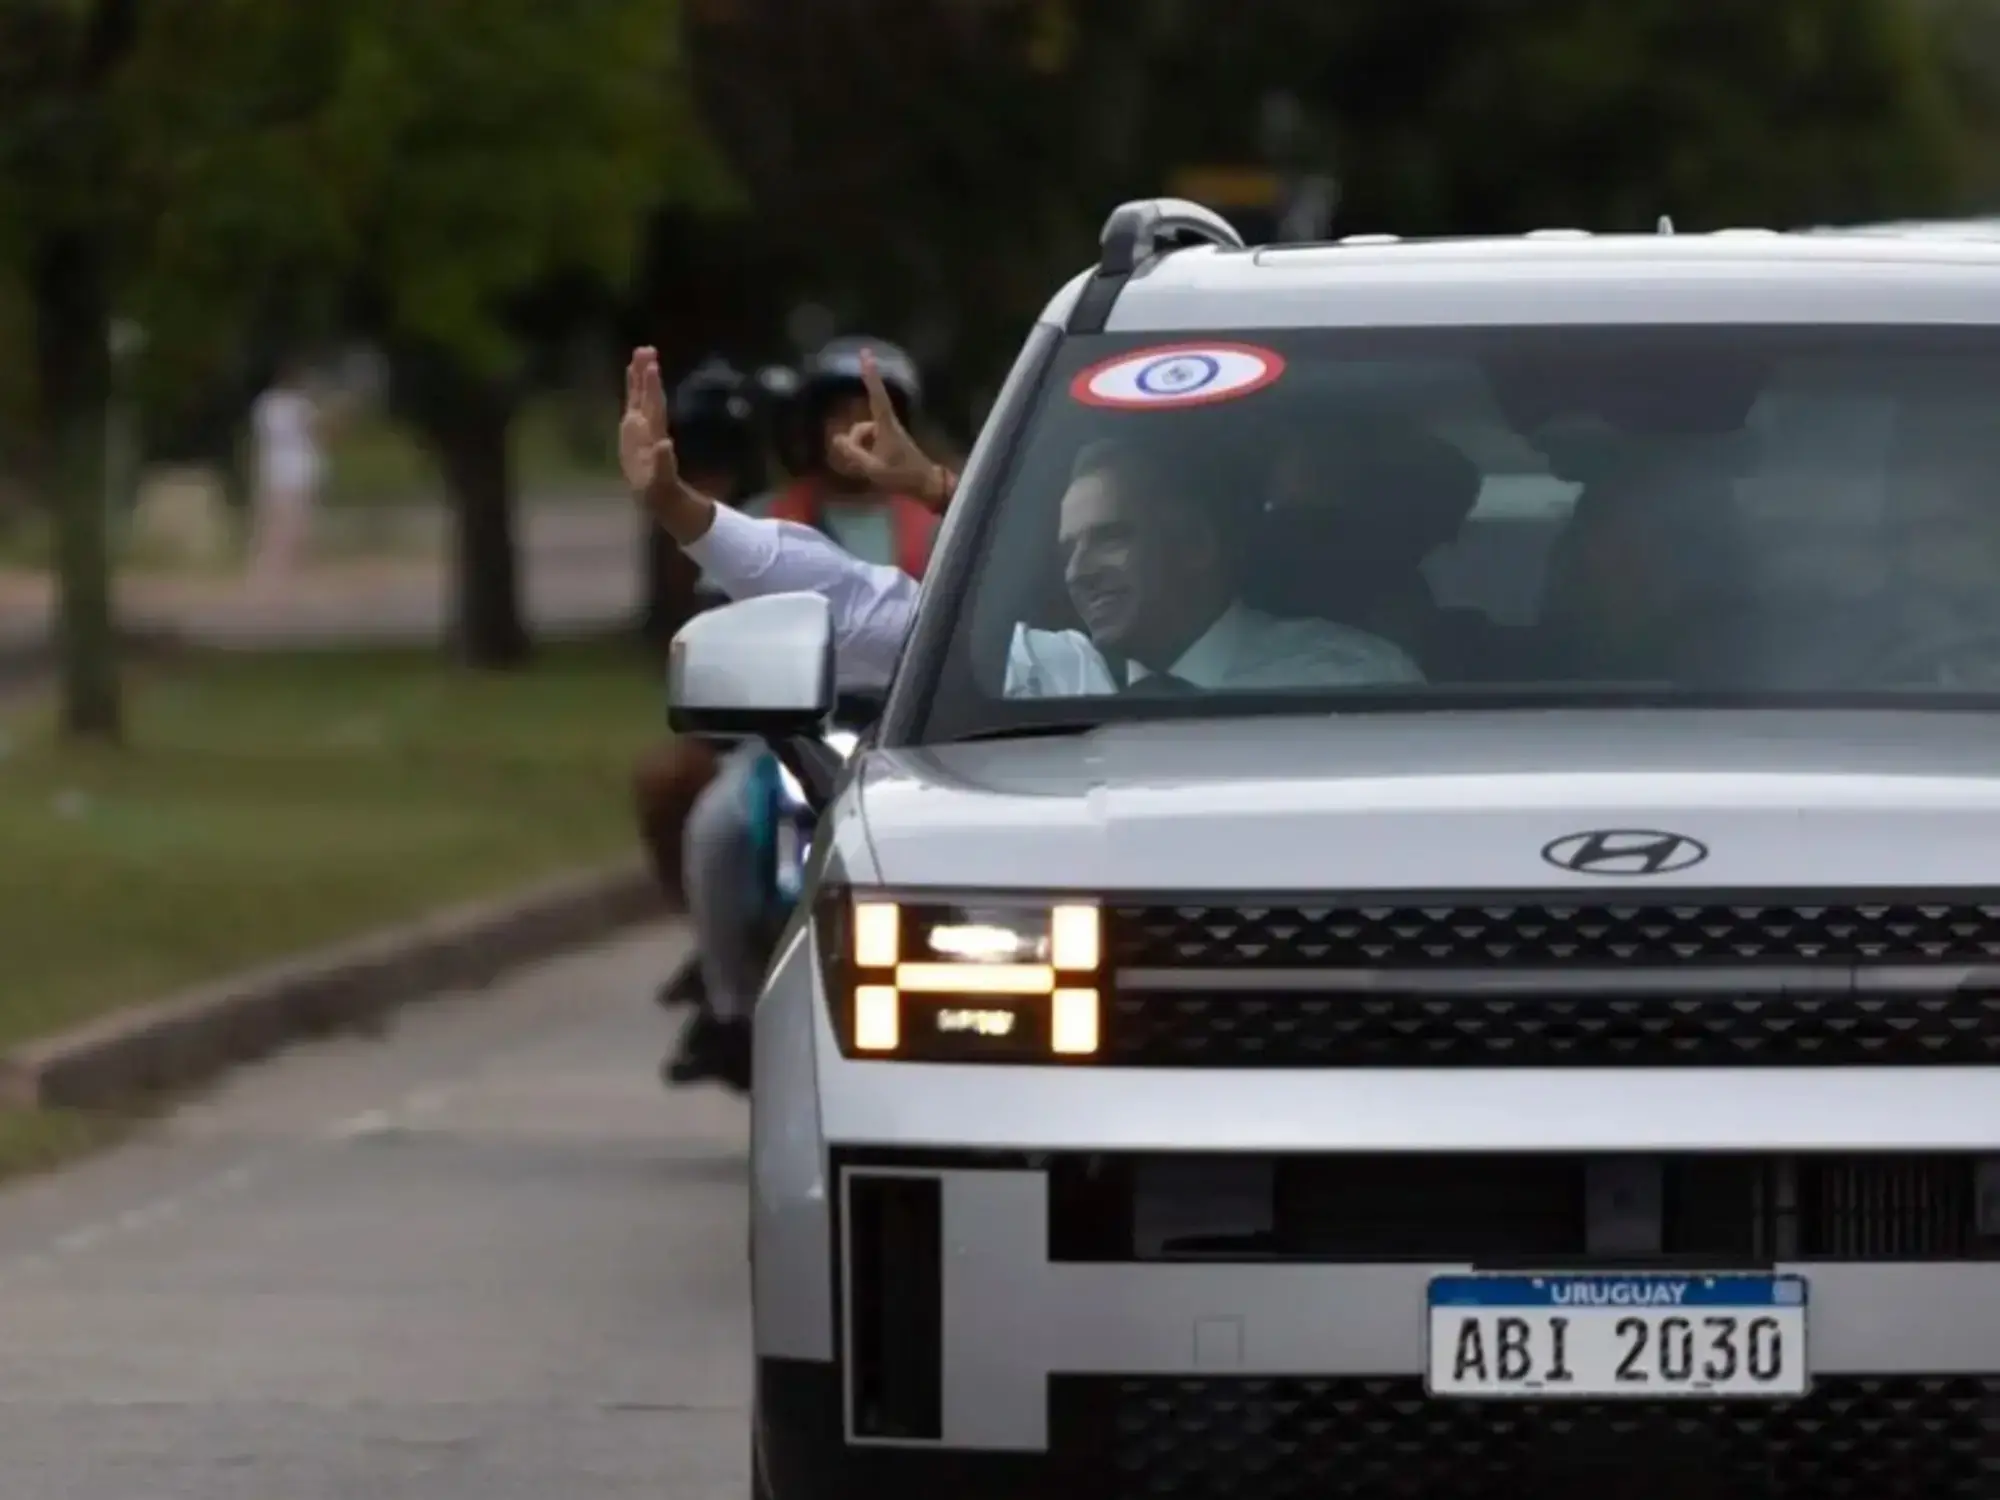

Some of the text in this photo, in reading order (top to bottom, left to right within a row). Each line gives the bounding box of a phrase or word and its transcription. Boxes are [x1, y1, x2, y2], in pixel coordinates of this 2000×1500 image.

[1550, 1282, 1688, 1305] URUGUAY
[1453, 1317, 1783, 1383] ABI 2030
